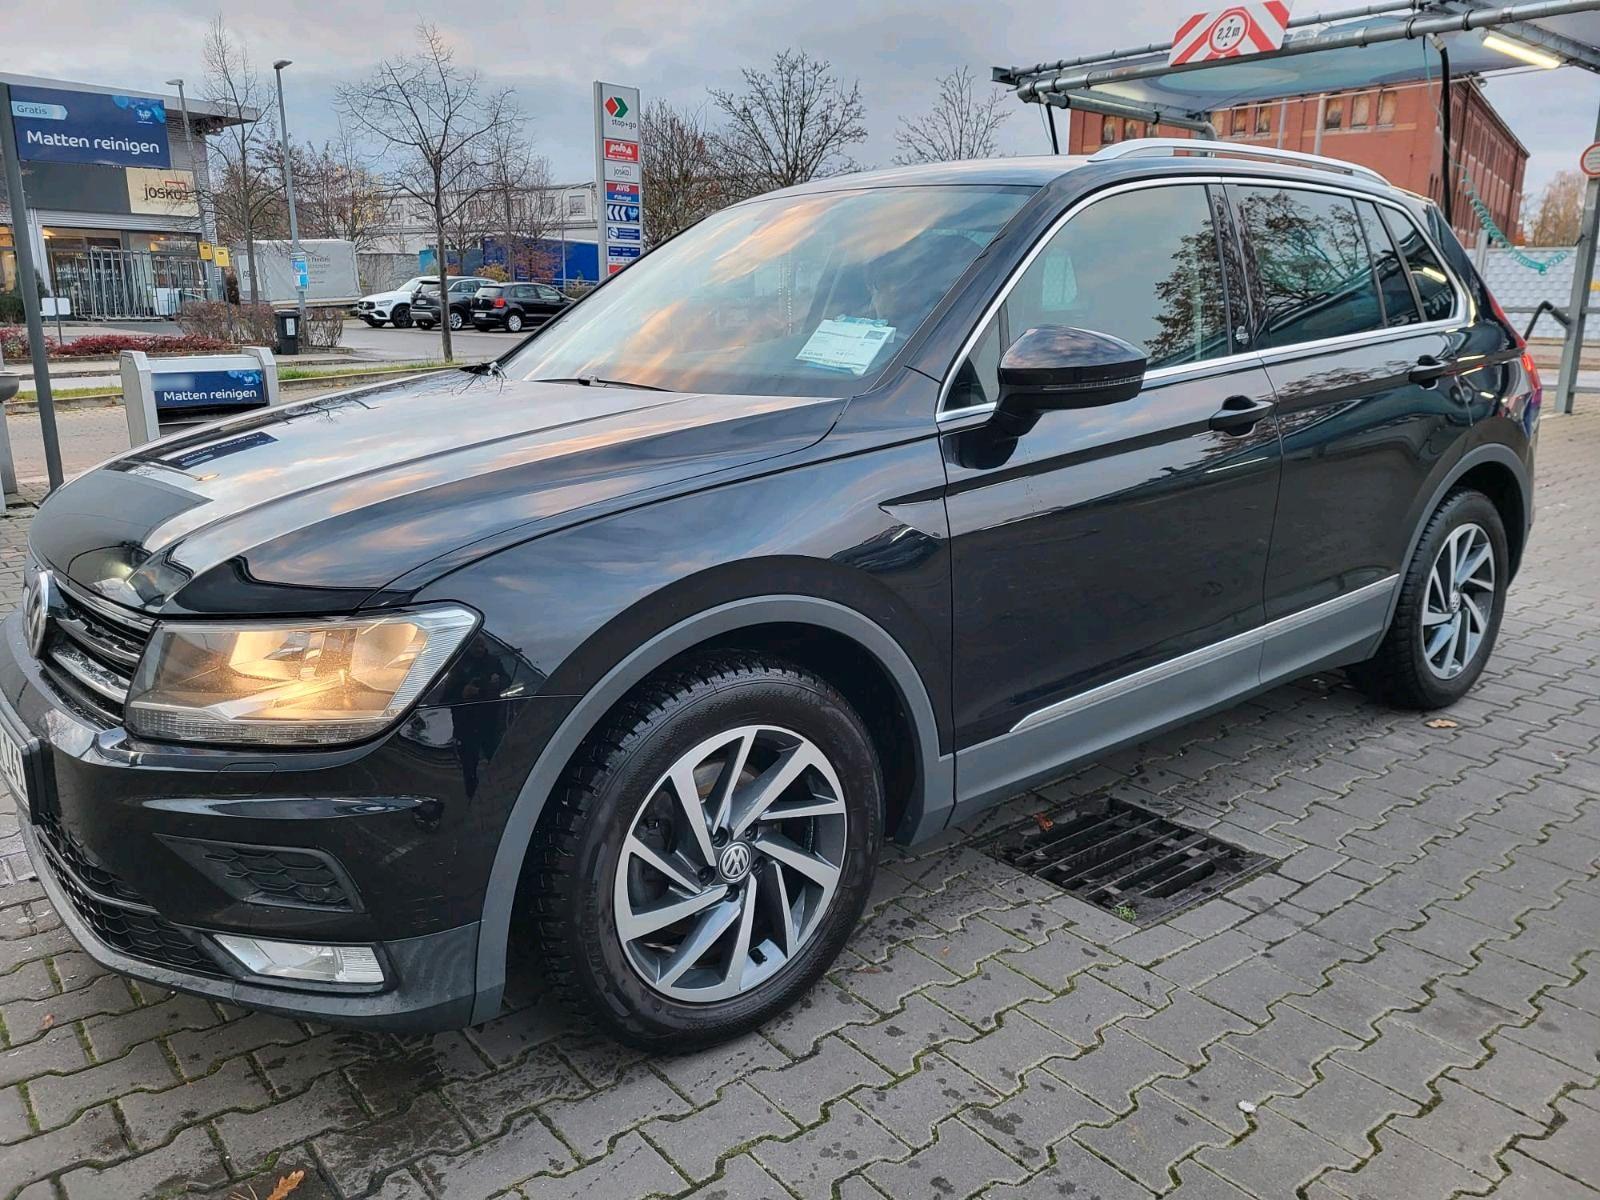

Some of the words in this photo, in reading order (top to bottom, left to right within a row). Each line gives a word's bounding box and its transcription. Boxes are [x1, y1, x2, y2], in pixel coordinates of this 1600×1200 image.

[1217, 26, 1231, 40] 2,2
[1231, 27, 1240, 37] m
[16, 104, 48, 115] Gratis
[27, 130, 90, 149] Matten
[93, 136, 160, 155] reinigen
[615, 184, 630, 193] AVIS
[164, 392, 207, 401] Matten
[210, 389, 257, 400] reinigen
